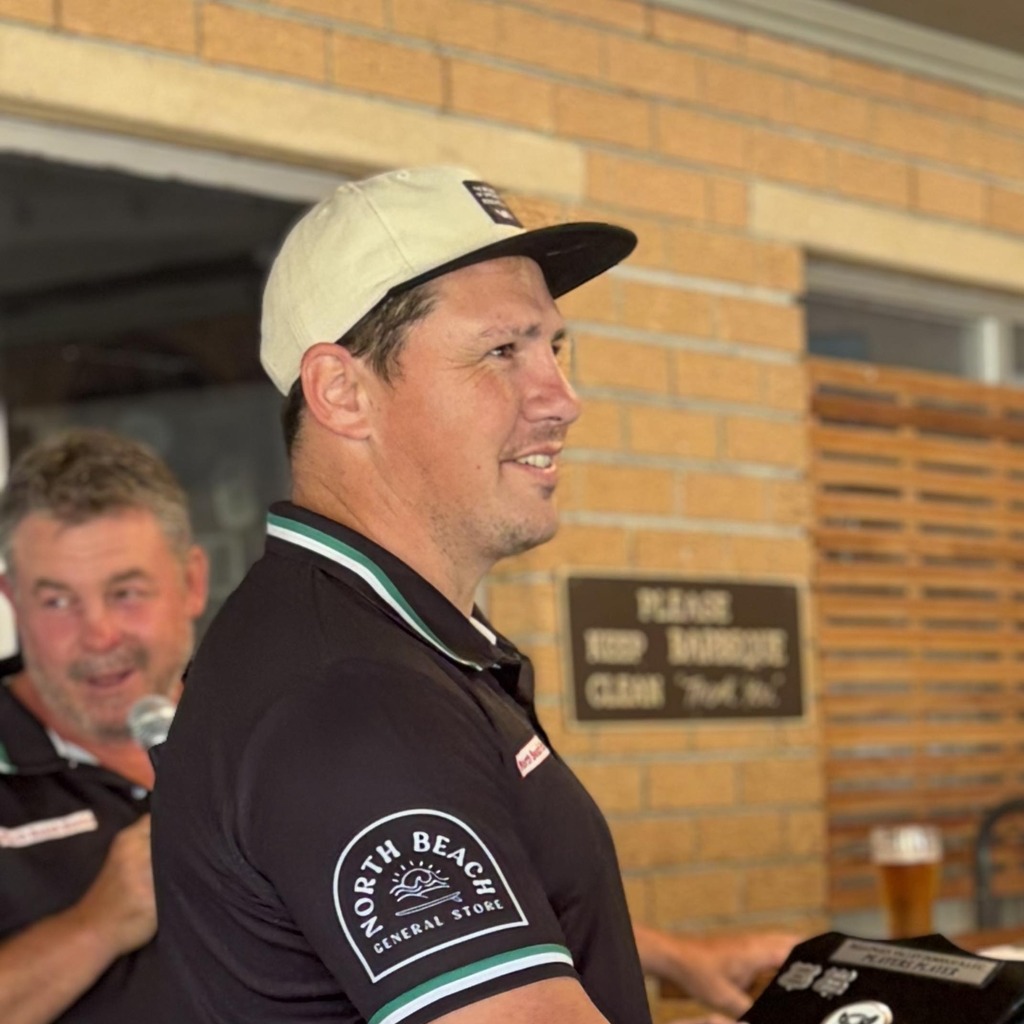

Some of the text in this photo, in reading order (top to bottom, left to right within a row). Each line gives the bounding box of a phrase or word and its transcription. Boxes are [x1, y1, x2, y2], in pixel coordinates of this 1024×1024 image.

[585, 672, 665, 710] CLEAN
[354, 831, 496, 939] NORTH BEACH
[373, 899, 504, 954] GENERAL STORE
